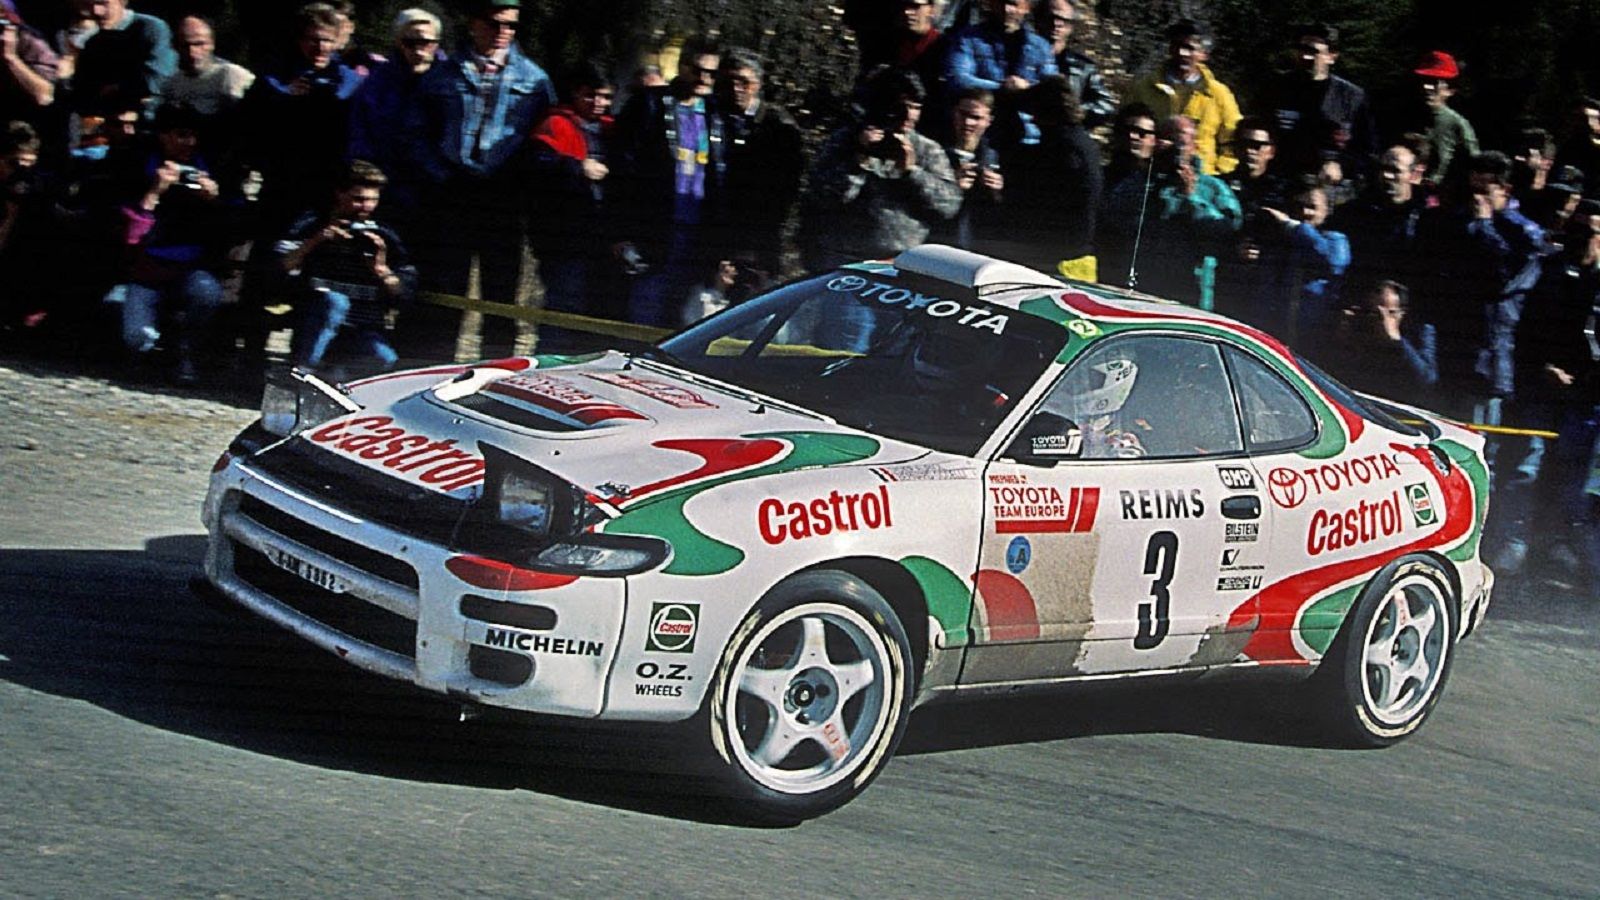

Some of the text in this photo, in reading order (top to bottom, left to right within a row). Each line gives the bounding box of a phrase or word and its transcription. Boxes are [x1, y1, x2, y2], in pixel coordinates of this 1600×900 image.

[859, 282, 1010, 336] TOYOTA
[311, 415, 486, 492] Castrol
[1220, 468, 1253, 488] OMP
[1304, 453, 1401, 494] TOYOTA
[990, 487, 1063, 504] TOYOTA
[1119, 488, 1205, 520] REIMS
[758, 485, 892, 545] Castrol
[994, 505, 1064, 518] TEAM EUROPE
[1307, 490, 1402, 556] Castrol
[1225, 523, 1259, 536] BILSTEIN
[1133, 530, 1179, 650] 3
[659, 621, 693, 634] Castrol
[485, 628, 604, 657] MICHELIN
[635, 662, 693, 682] O.Z.
[634, 683, 684, 698] WHEELS
